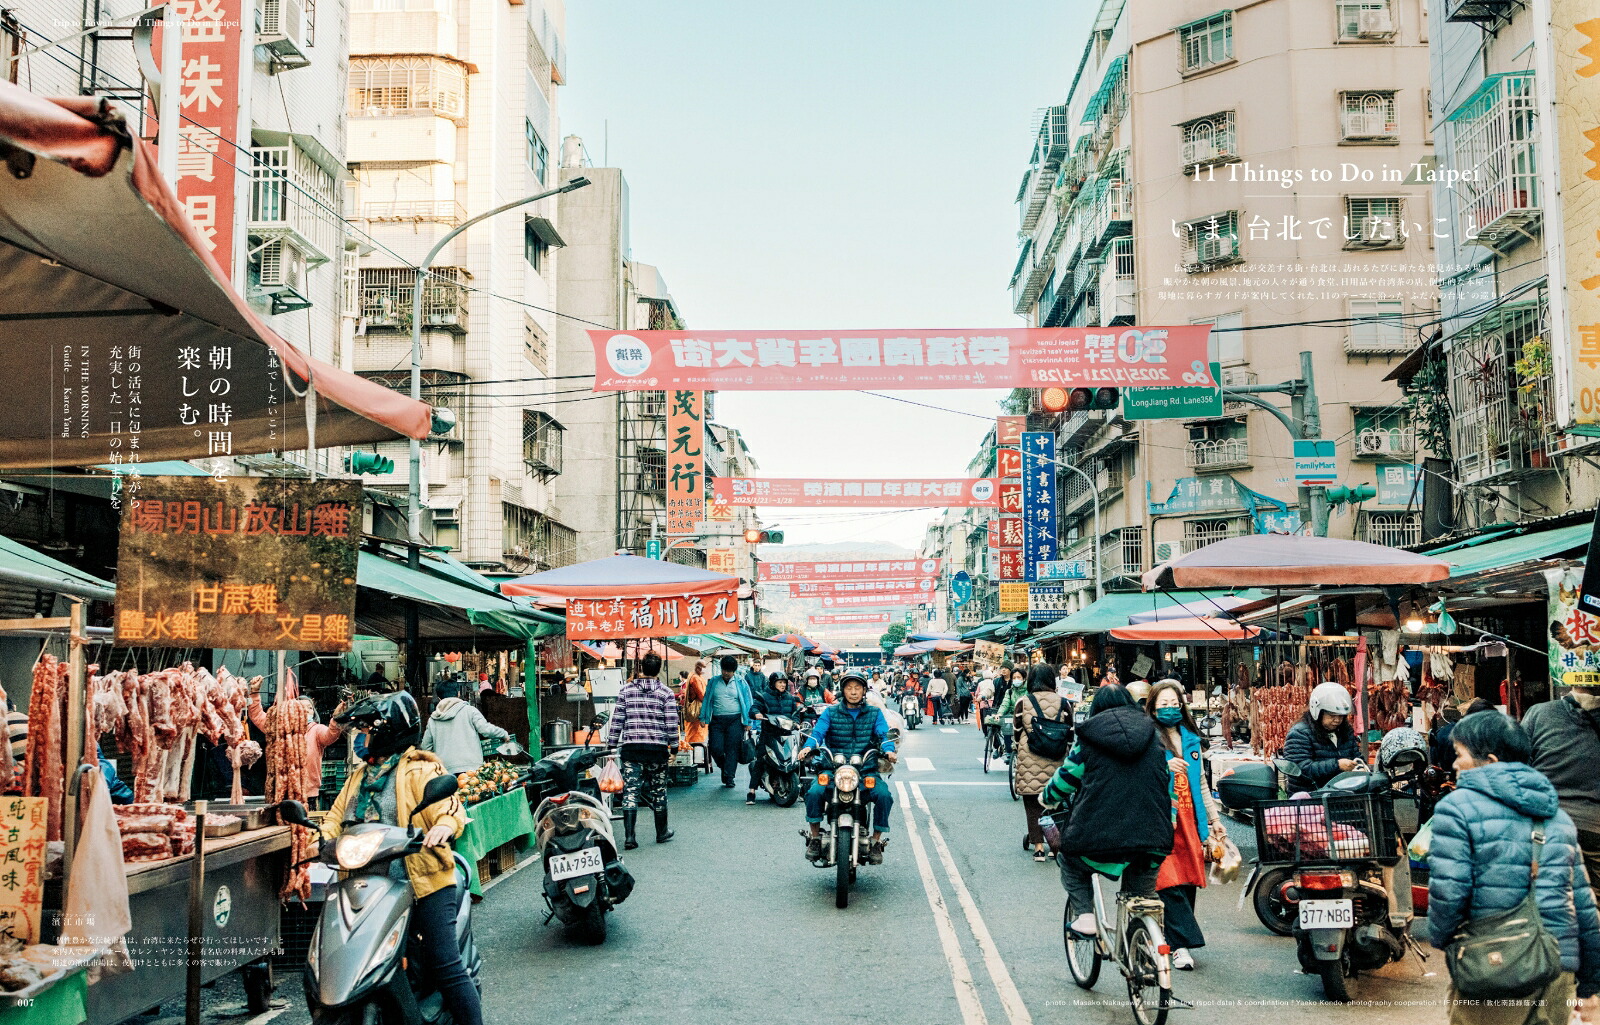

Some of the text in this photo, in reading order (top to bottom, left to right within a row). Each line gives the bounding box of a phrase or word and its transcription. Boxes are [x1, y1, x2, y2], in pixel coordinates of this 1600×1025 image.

[1131, 395, 1214, 409] LongJiang Rd. Lane356
[1295, 461, 1336, 473] FamilyMart
[1002, 420, 1023, 545] 三仁肉鬆
[130, 500, 350, 537] 陽明山放山雞
[709, 553, 735, 567] 商行
[1001, 553, 1014, 578] 批發
[196, 582, 278, 615] 甘蔗雞
[568, 600, 626, 618] 迪化街
[630, 595, 737, 629] 福州魚丸
[119, 609, 199, 641] 鹽水雞
[276, 613, 350, 644] 文昌雞
[569, 619, 625, 633] 70年老店
[1566, 609, 1600, 644] 牧
[1562, 652, 1600, 669] 甘蔗
[553, 854, 601, 875] AAA-7936
[1301, 908, 1351, 924] 377-NBG
